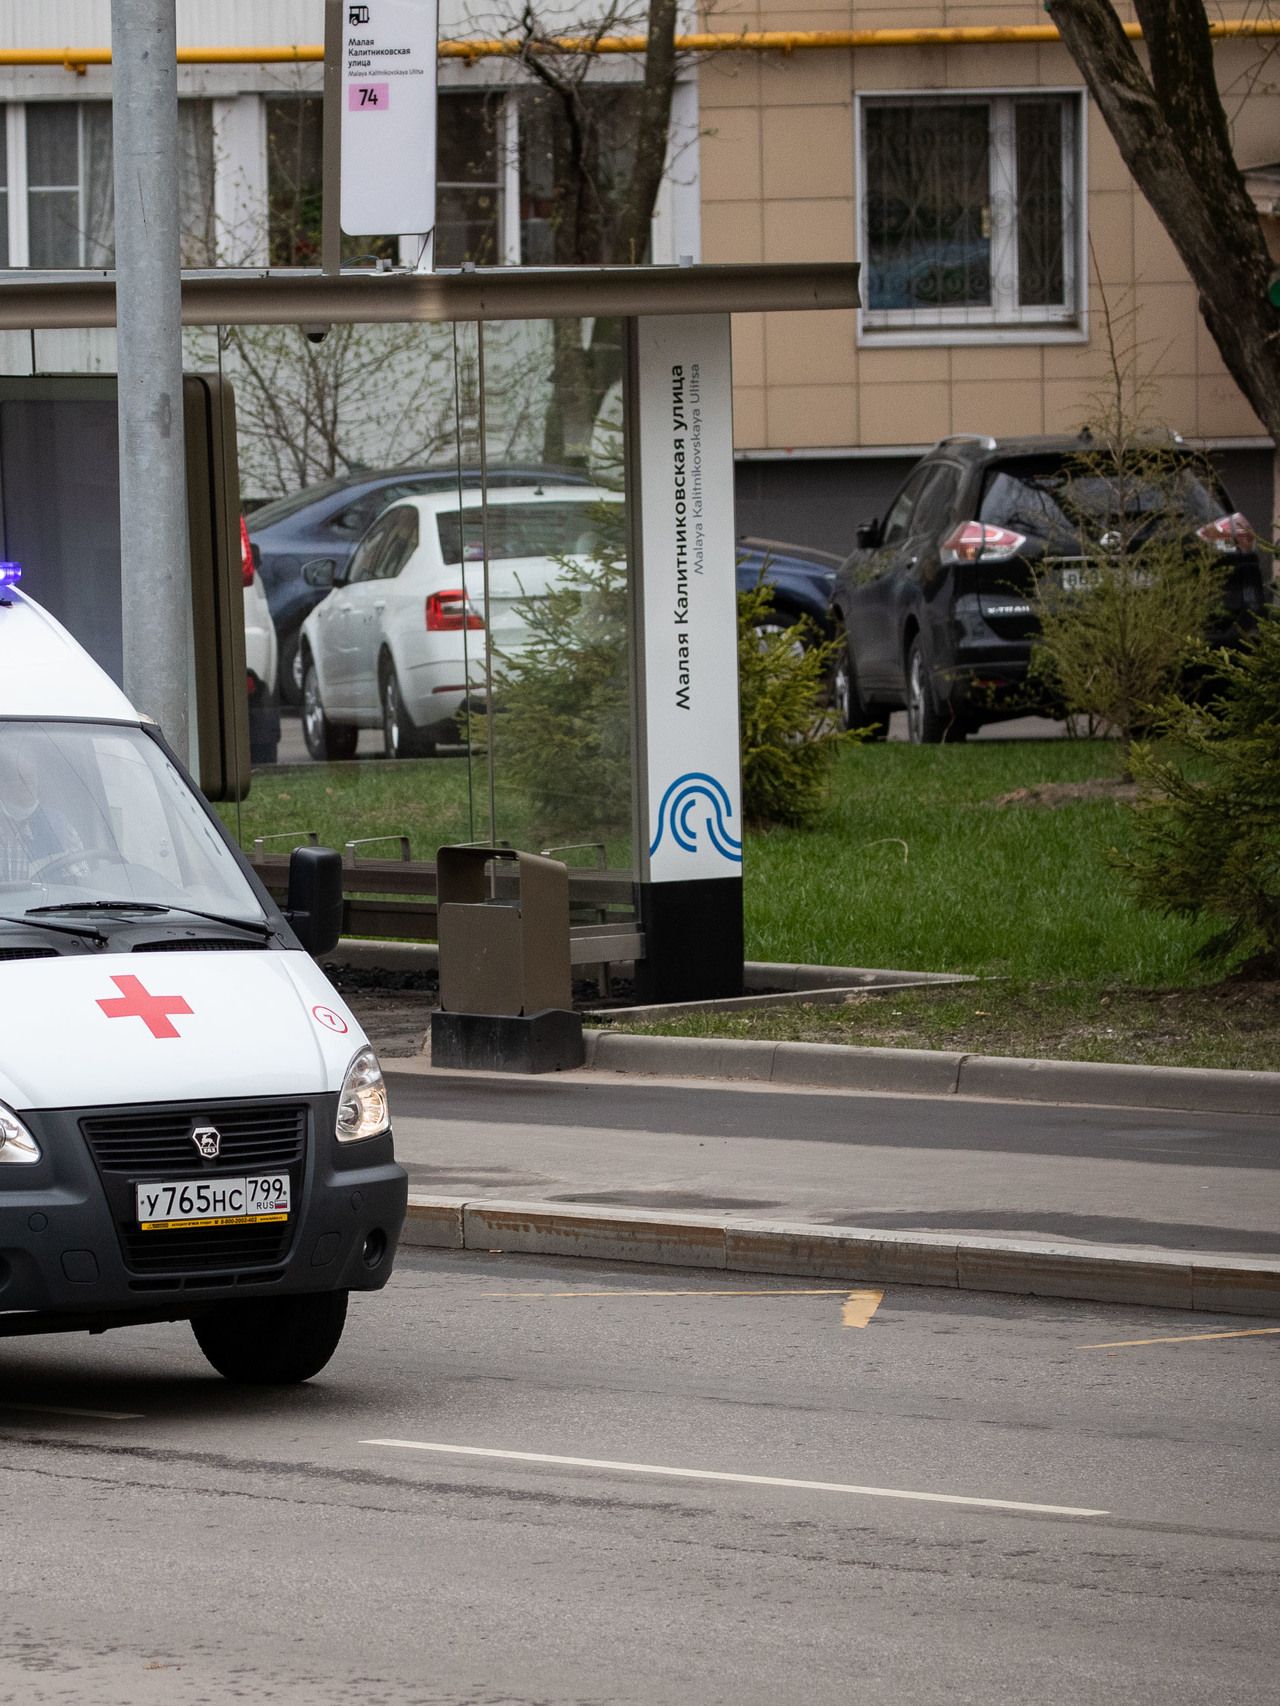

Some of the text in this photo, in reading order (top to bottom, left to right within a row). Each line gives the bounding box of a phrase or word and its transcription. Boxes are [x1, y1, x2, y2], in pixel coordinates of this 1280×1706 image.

[348, 38, 374, 46] Малая
[348, 48, 411, 57] Калитниковская
[348, 59, 371, 69] улица
[359, 88, 378, 106] 74
[690, 363, 705, 575] Malaya Kalitnikovskaya Ulitsa
[672, 364, 690, 710] Малая Калитниковская улица
[248, 1178, 283, 1202] 799
[256, 1201, 274, 1210] RUS
